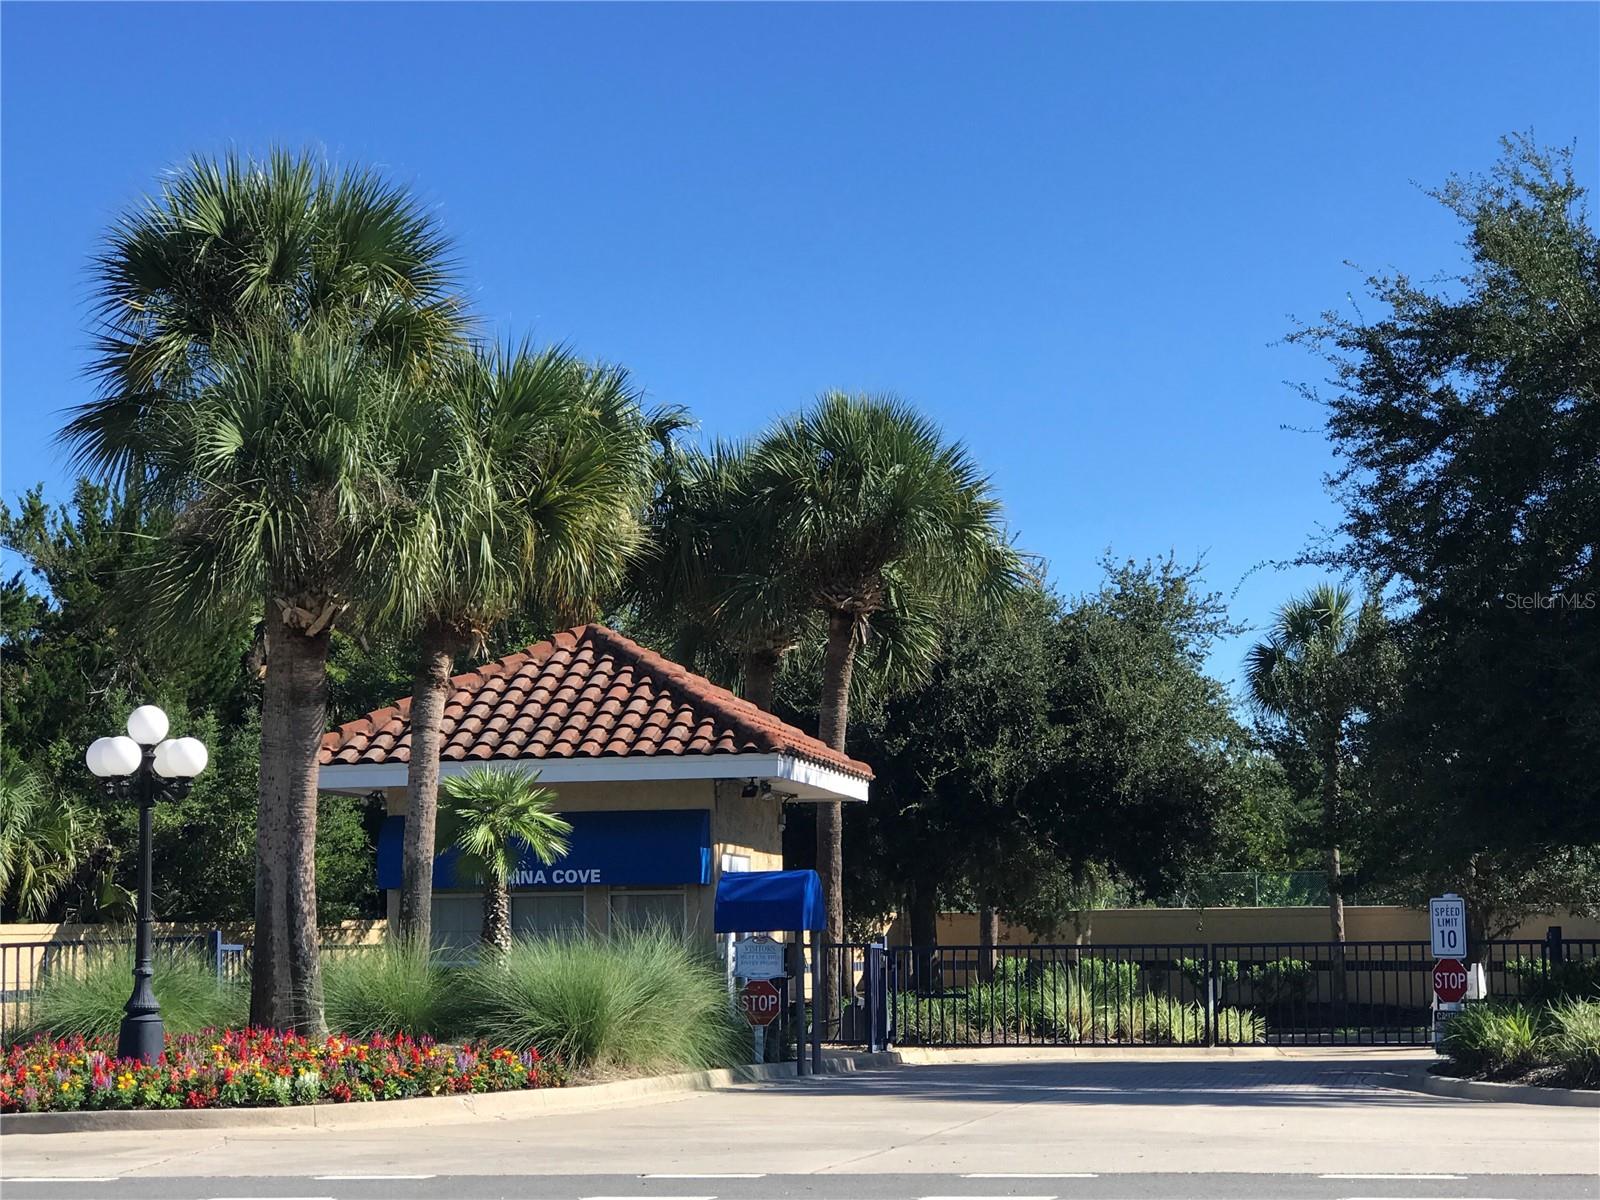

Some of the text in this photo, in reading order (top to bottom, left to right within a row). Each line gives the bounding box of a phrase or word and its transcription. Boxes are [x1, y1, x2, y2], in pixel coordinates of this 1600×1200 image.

[475, 869, 601, 884] INA COVE
[1435, 907, 1460, 917] SPEED
[1437, 918, 1458, 927] LIMIT
[1440, 930, 1457, 948] 10
[1435, 972, 1466, 989] STOP
[741, 994, 777, 1011] STOP
